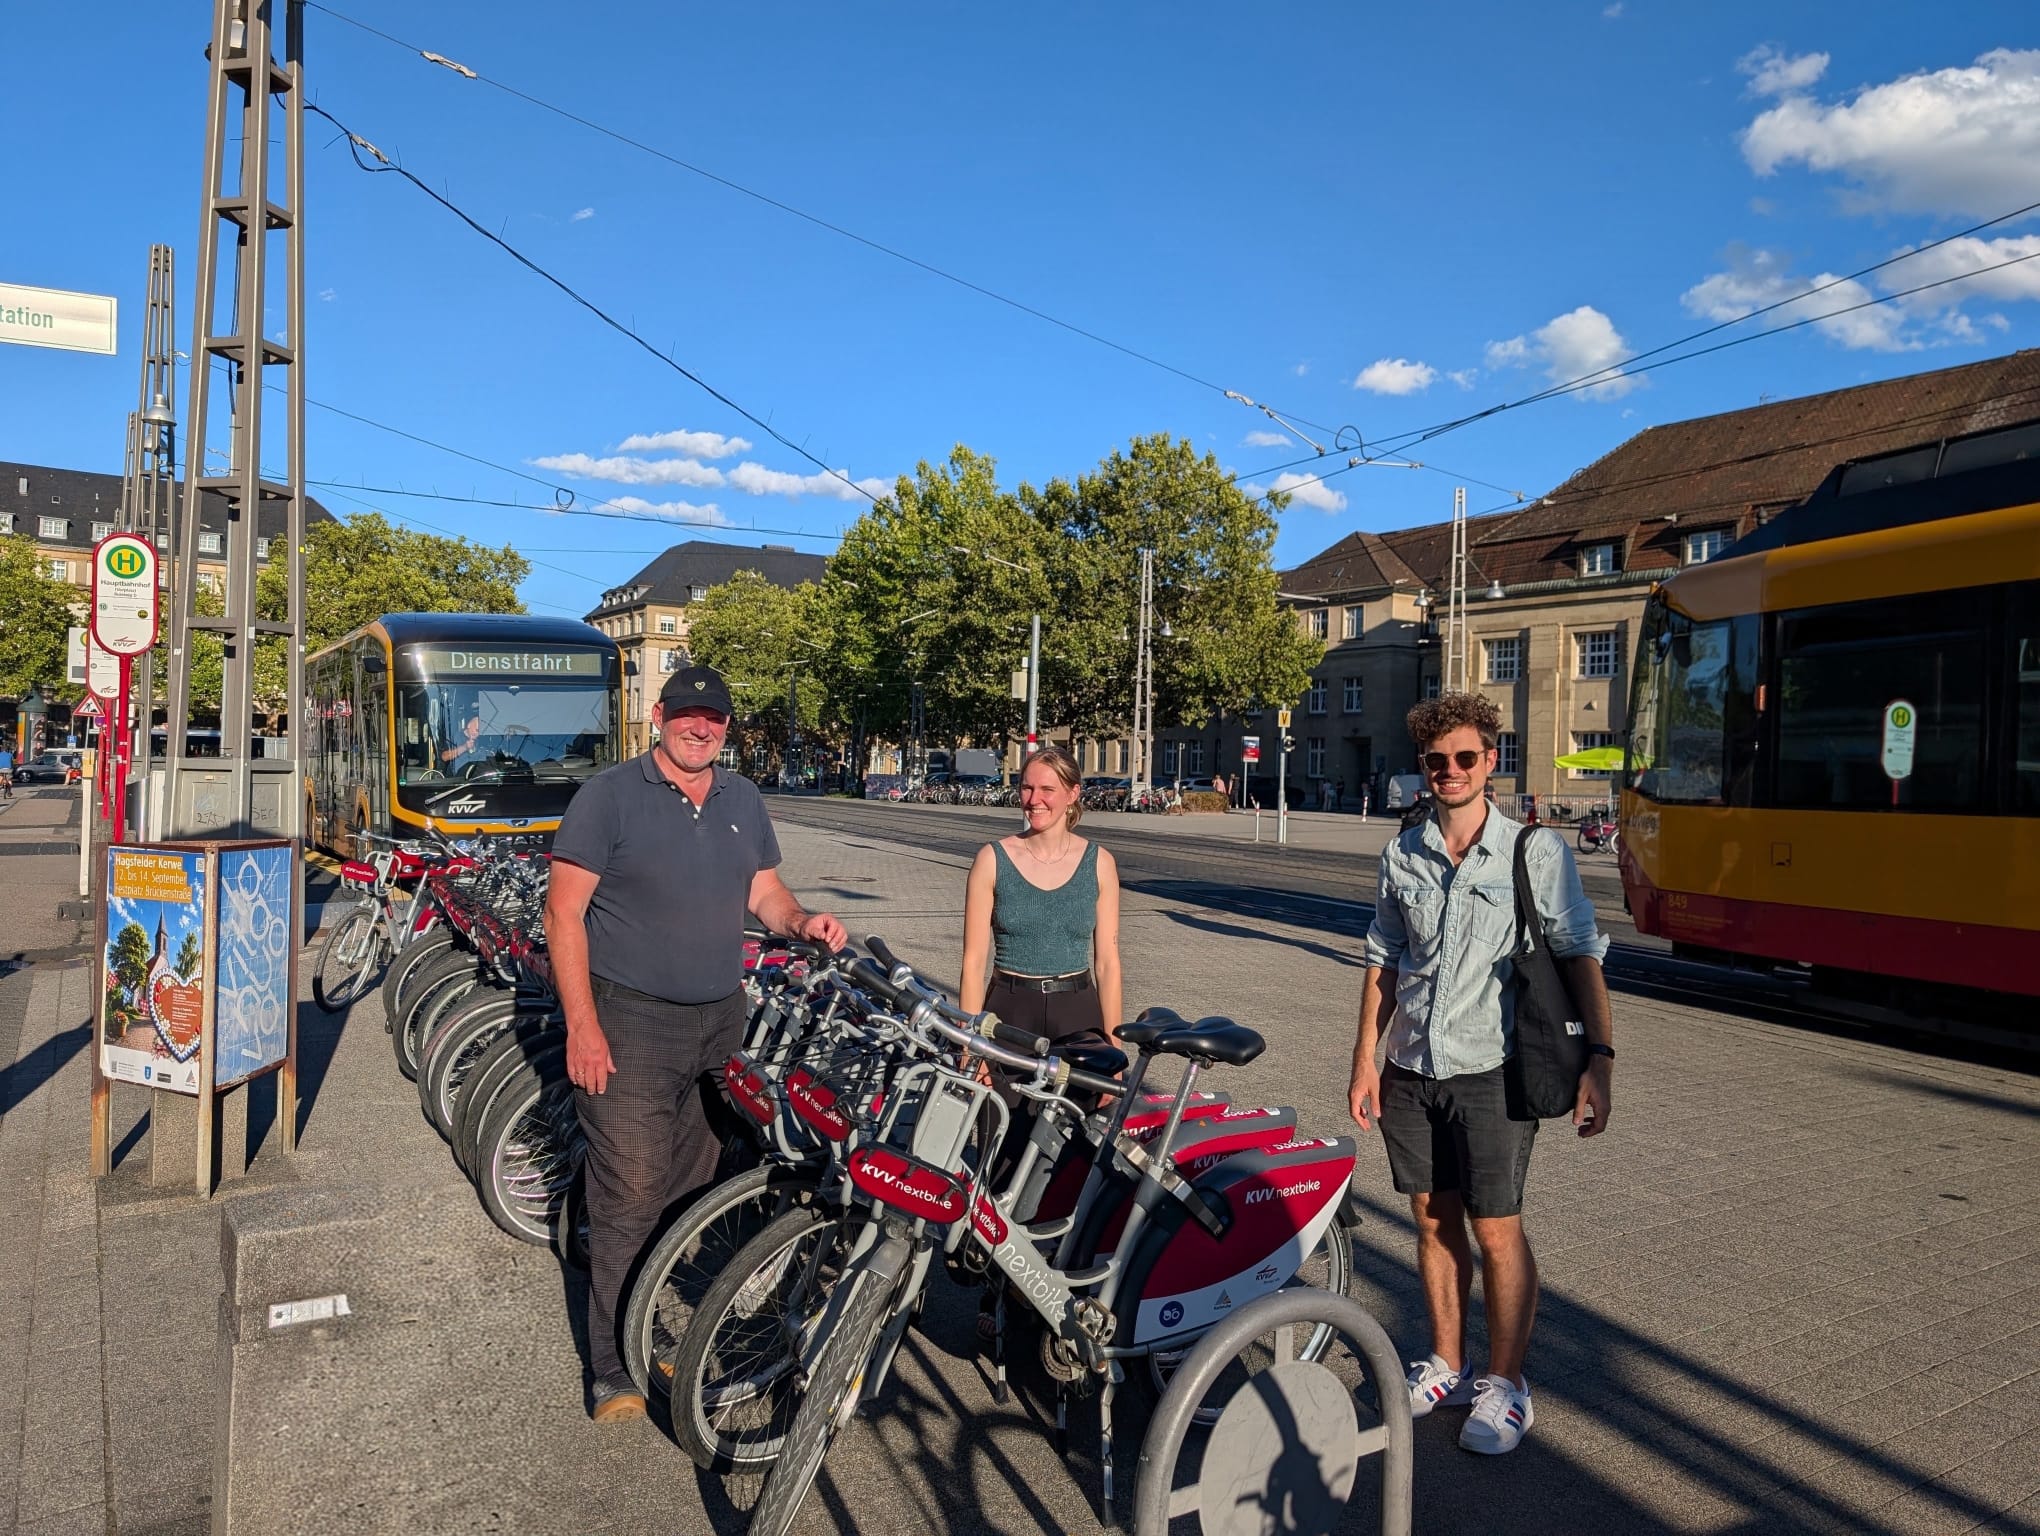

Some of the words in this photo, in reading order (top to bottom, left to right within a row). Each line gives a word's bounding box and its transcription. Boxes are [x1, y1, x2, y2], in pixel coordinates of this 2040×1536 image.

[118, 552, 134, 571] H
[101, 579, 150, 588] Hauptbahnhof
[451, 652, 572, 671] Dienstfahrt
[1282, 712, 1288, 725] V
[115, 855, 156, 869] Hagsfelder
[158, 858, 183, 869] Kerwe
[116, 869, 126, 880] 12.
[127, 870, 137, 881] bis
[140, 870, 150, 882] 14.
[152, 871, 187, 886] September
[115, 883, 144, 896] Festplatz
[145, 885, 192, 900] Brückenstraße
[1668, 895, 1687, 908] 849
